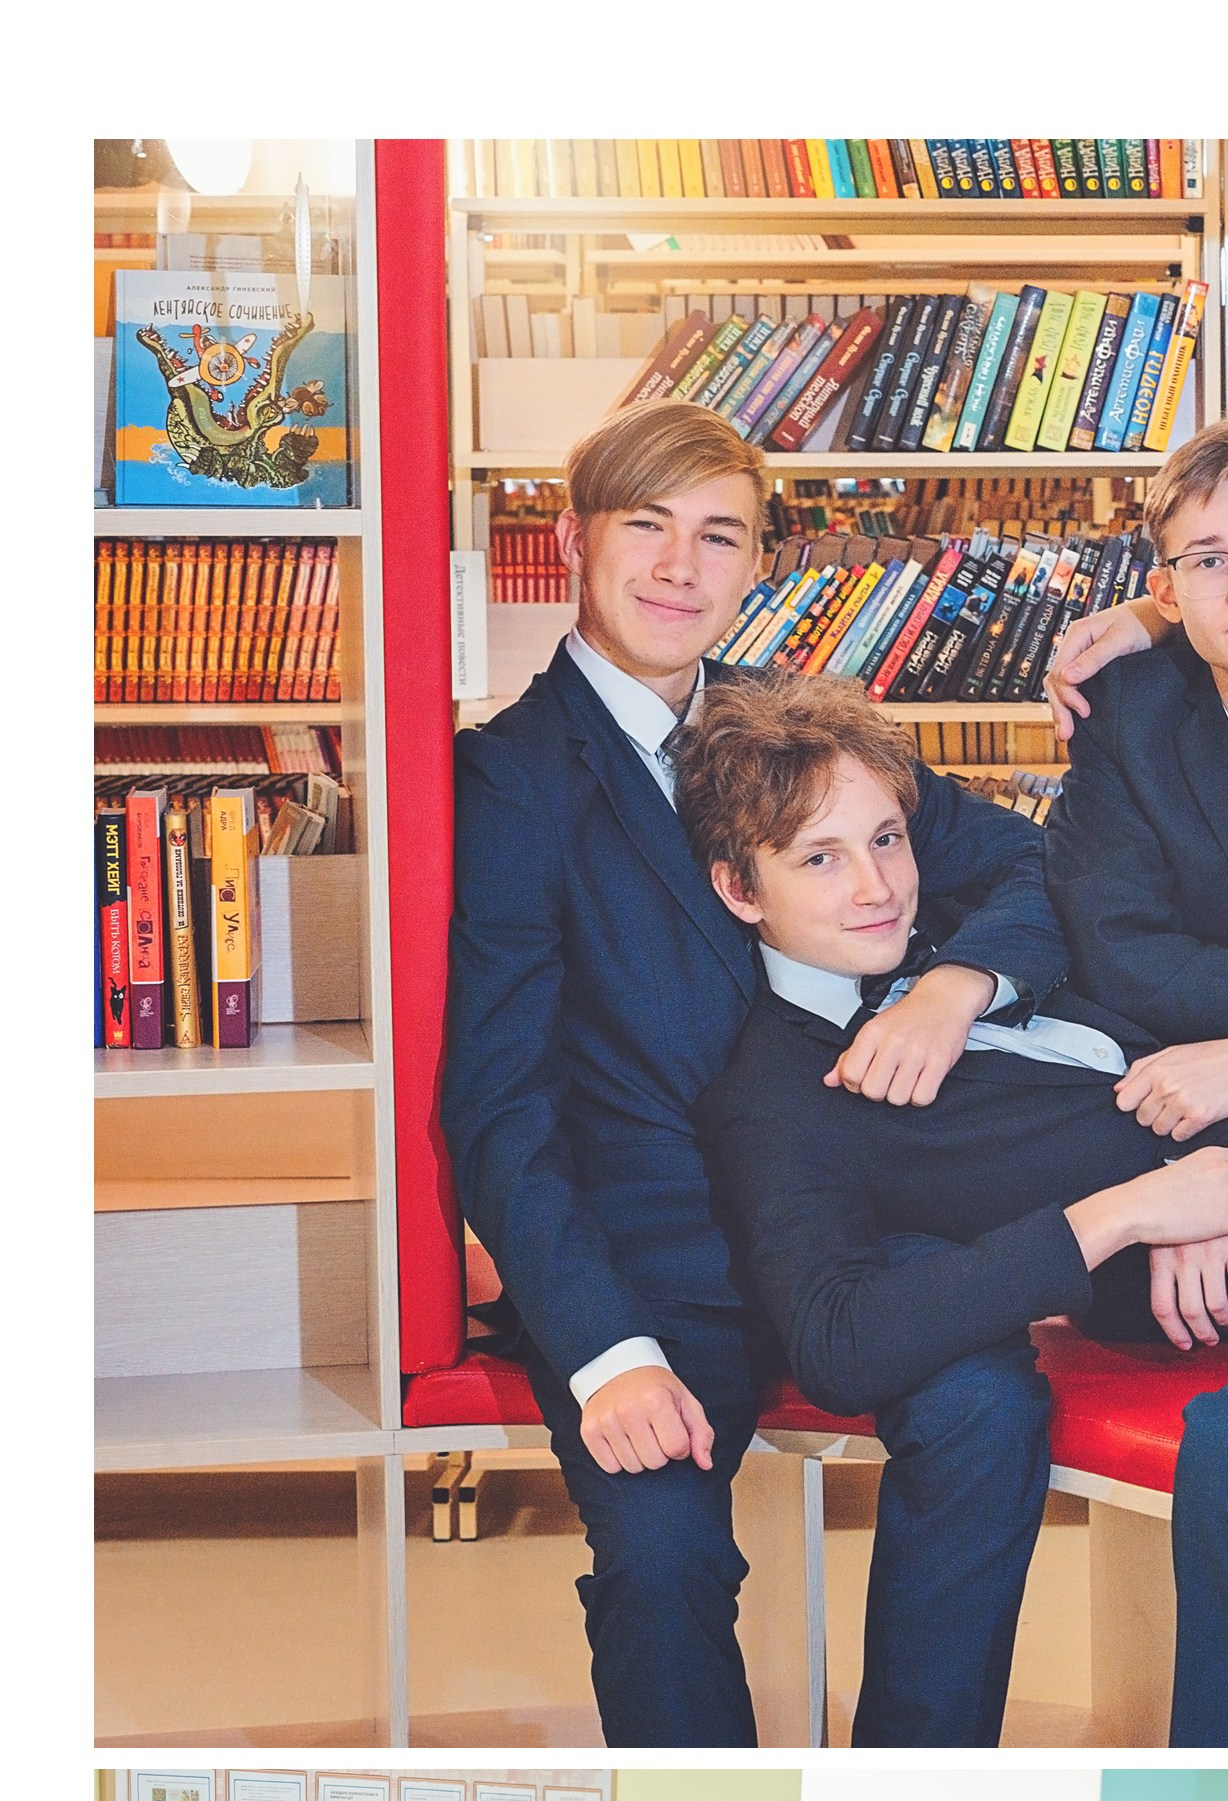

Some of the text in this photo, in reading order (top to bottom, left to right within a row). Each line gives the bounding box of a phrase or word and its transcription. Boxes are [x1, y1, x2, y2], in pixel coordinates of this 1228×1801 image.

[153, 299, 293, 323] ЛЕНТЯЙСКОЕ СОЧИНЕНИЕ
[232, 285, 276, 293] ГИНЕВСКИЙ
[787, 373, 827, 423] телескоп
[796, 376, 840, 430] Янтарный
[908, 362, 939, 428] Чудесный нож
[1129, 350, 1164, 426] ГИДЕОН
[1158, 343, 1187, 431] НЕБЕСНЫЙ ОХОТНИК
[922, 569, 948, 605] ИДЕАЛ
[454, 563, 467, 686] Детективные повести
[905, 628, 933, 672] ЛАРРИ
[932, 627, 960, 674] ЛАРРИ
[1017, 602, 1056, 678] БОЛЬШИЕ ВОДЫ
[974, 651, 991, 678] ВЕТЕР
[985, 638, 997, 653] НА
[104, 824, 121, 895] МЭТТ ХЕЙГ
[109, 908, 121, 974] БЫТЬ КОТОМ
